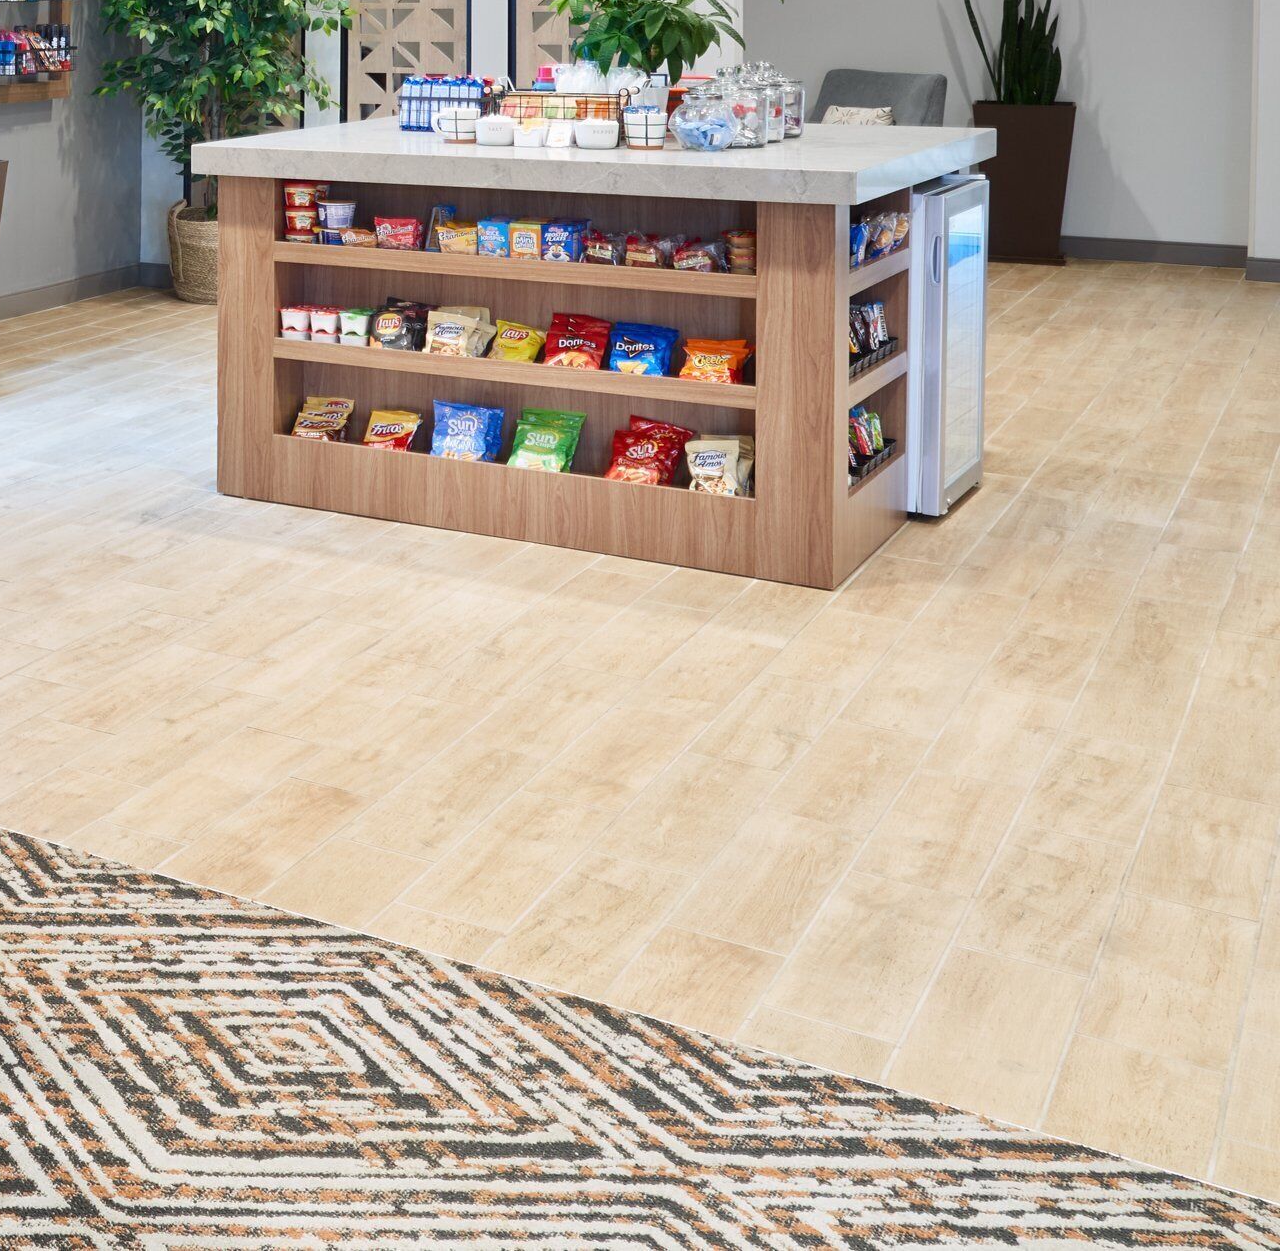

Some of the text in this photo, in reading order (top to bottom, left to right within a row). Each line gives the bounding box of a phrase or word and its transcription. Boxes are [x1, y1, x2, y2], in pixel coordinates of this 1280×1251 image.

[377, 316, 401, 329] Lay's
[501, 328, 529, 340] Lay's
[558, 337, 597, 348] Doritos
[615, 341, 655, 352] Doritos
[371, 423, 404, 435] Fritos
[448, 418, 478, 435] Sun
[525, 431, 557, 446] Sun
[626, 441, 657, 458] Sun
[692, 452, 727, 465] Famous
[697, 459, 722, 468] Amos
